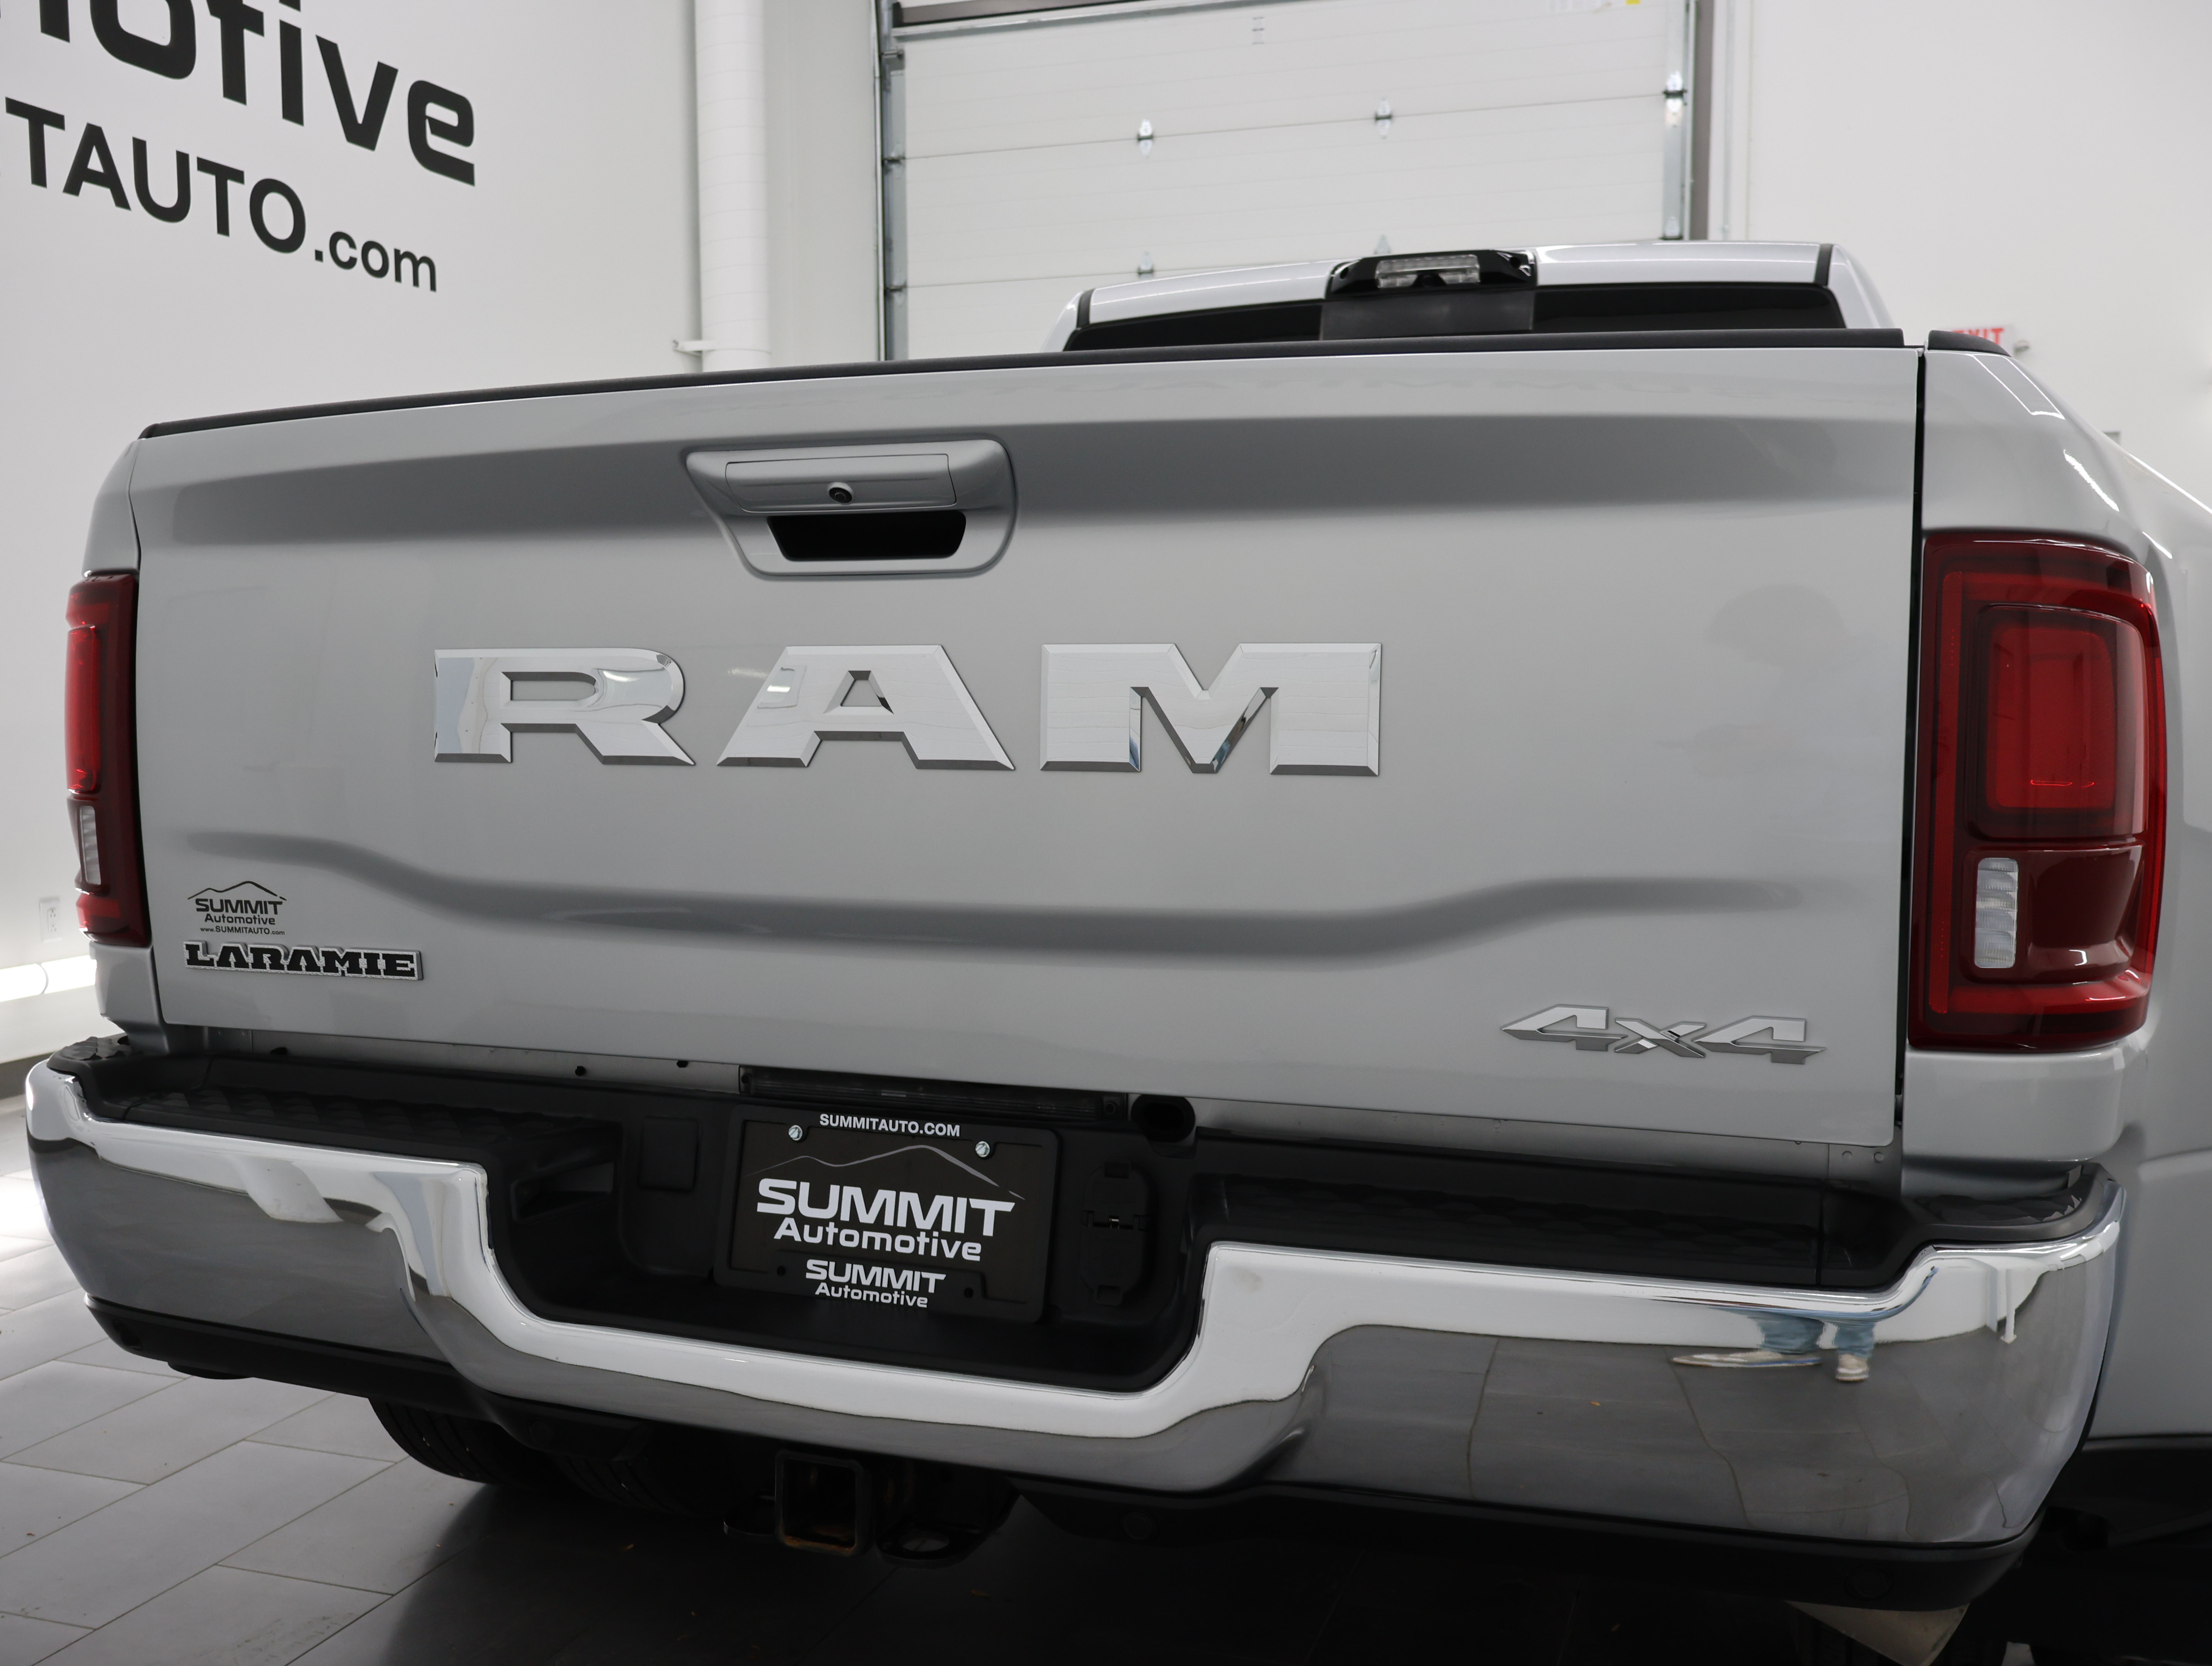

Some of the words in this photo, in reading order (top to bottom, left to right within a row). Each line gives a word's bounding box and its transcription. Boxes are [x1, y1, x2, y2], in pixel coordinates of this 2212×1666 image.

[0, 0, 475, 186] otive
[434, 642, 1382, 776] RAM
[195, 898, 283, 915] SUMMIT
[204, 913, 275, 925] Automotive
[200, 926, 285, 935] www.SUMMITAUTO.com
[183, 940, 424, 981] LARAMIE
[820, 1114, 960, 1137] SUMMITAUTO.COM
[757, 1178, 1015, 1236] SUMMIT
[774, 1217, 982, 1261] Automotive
[806, 1259, 946, 1293] SUMMIT
[815, 1282, 928, 1308] Automotive
